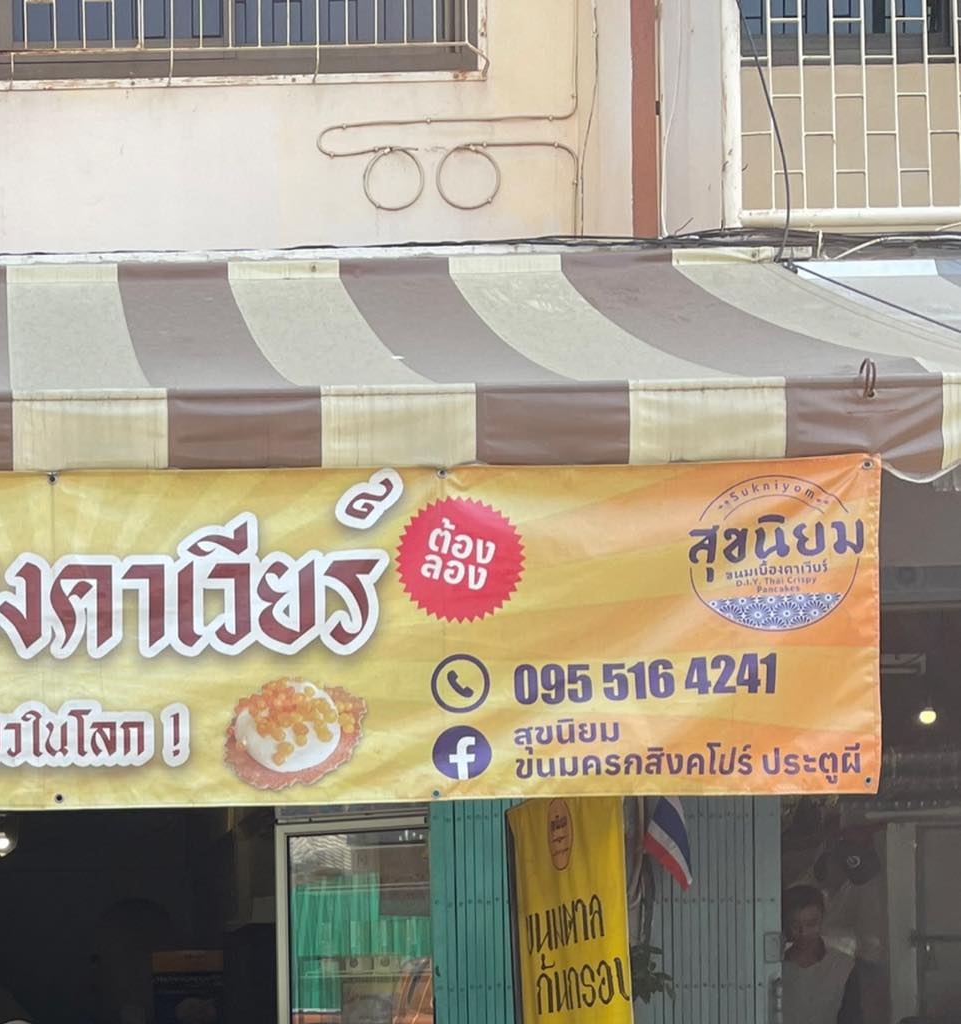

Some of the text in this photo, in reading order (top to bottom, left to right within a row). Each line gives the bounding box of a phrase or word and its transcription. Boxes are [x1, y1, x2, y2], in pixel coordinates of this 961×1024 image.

[427, 517, 496, 565] ต้อง
[689, 514, 865, 583] สุขนิยม
[421, 554, 489, 591] ลอง
[756, 585, 801, 594] Pancakes
[765, 576, 784, 585] Thai
[787, 576, 817, 586] Crispy
[513, 652, 777, 706] 095 516 4241
[513, 717, 620, 756] สุขนิยม
[515, 742, 862, 785] ขนมครกสิงคโปร์ ประตูผี
